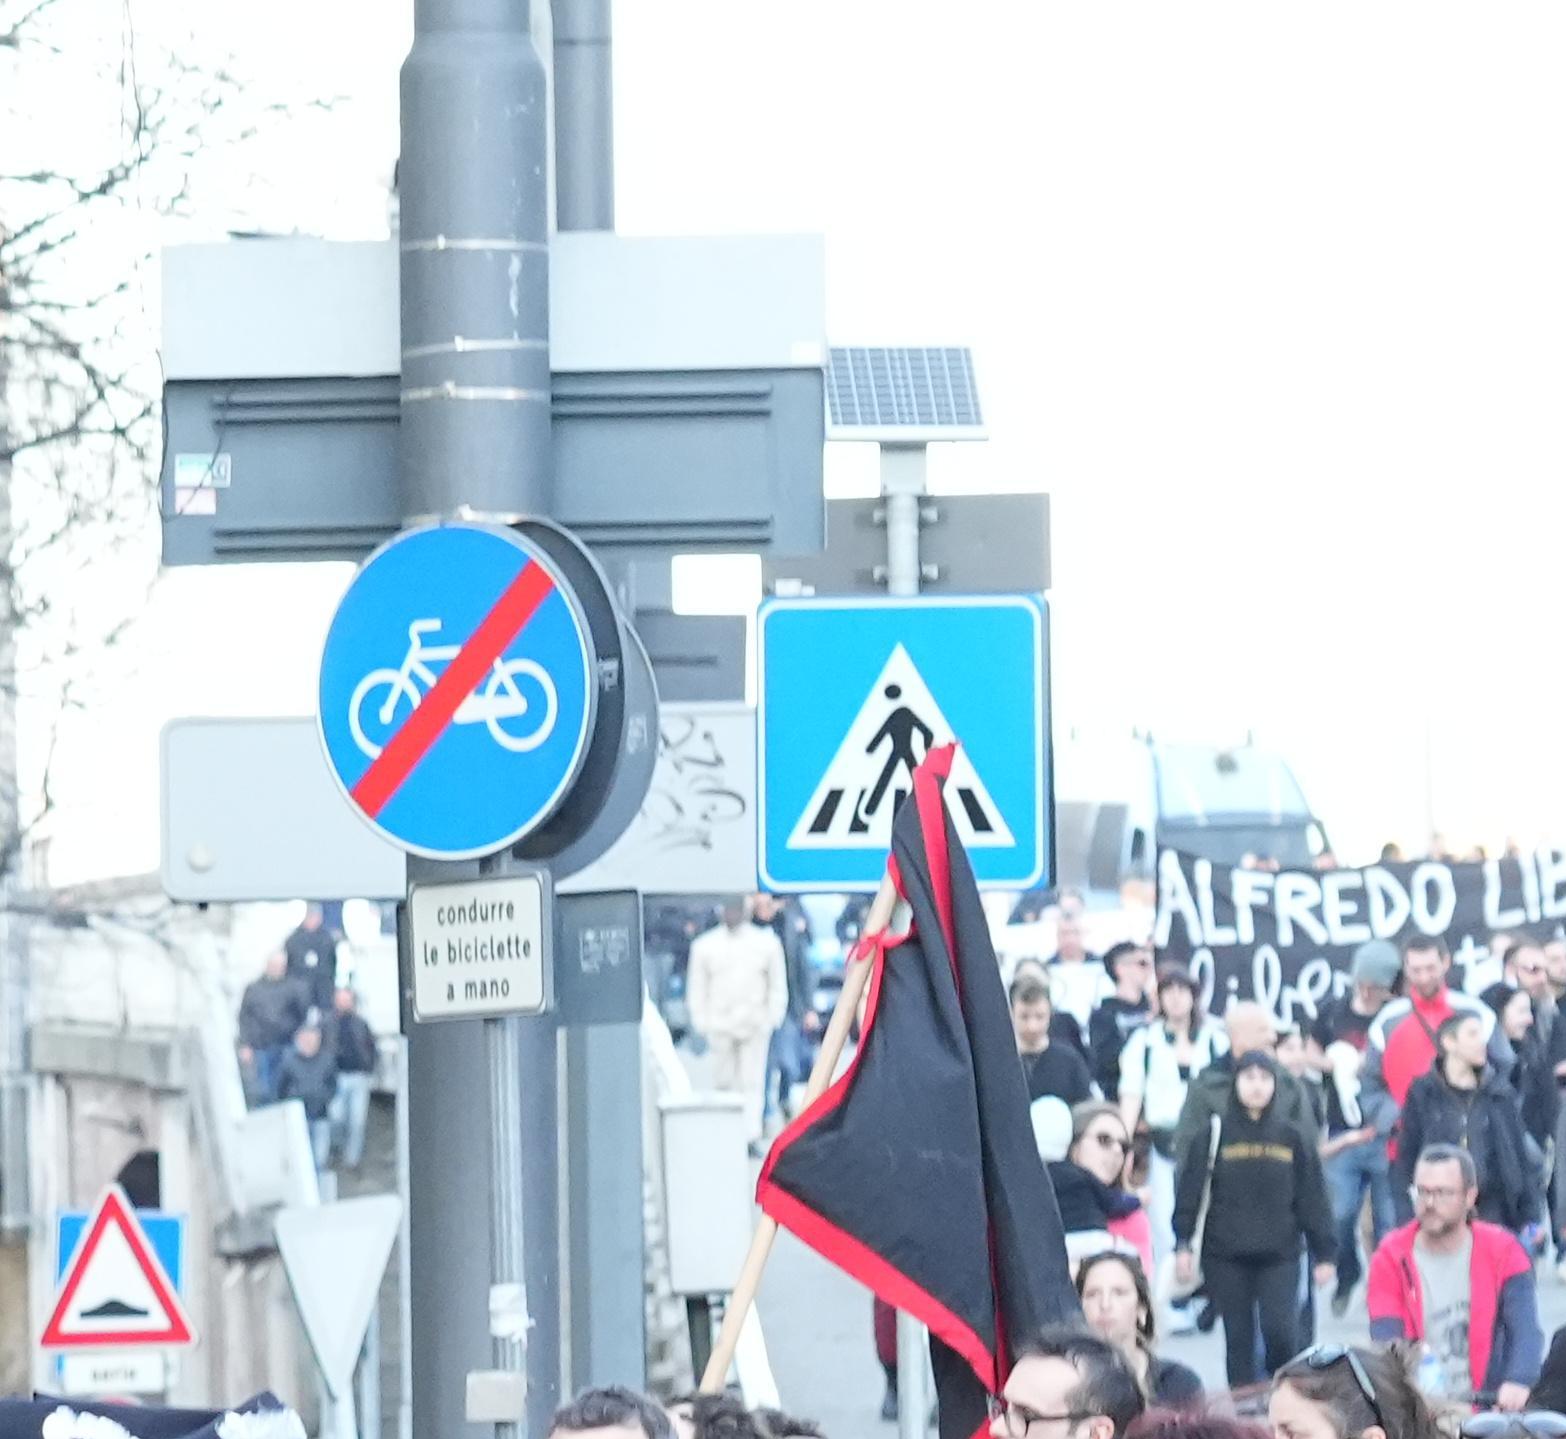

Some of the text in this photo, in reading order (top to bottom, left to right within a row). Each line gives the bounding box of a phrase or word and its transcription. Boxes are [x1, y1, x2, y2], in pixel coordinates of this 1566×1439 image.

[437, 897, 515, 926] condurre
[1155, 849, 1457, 947] ALFREDO
[423, 934, 531, 967] le biciclette
[446, 977, 510, 1001] a mano
